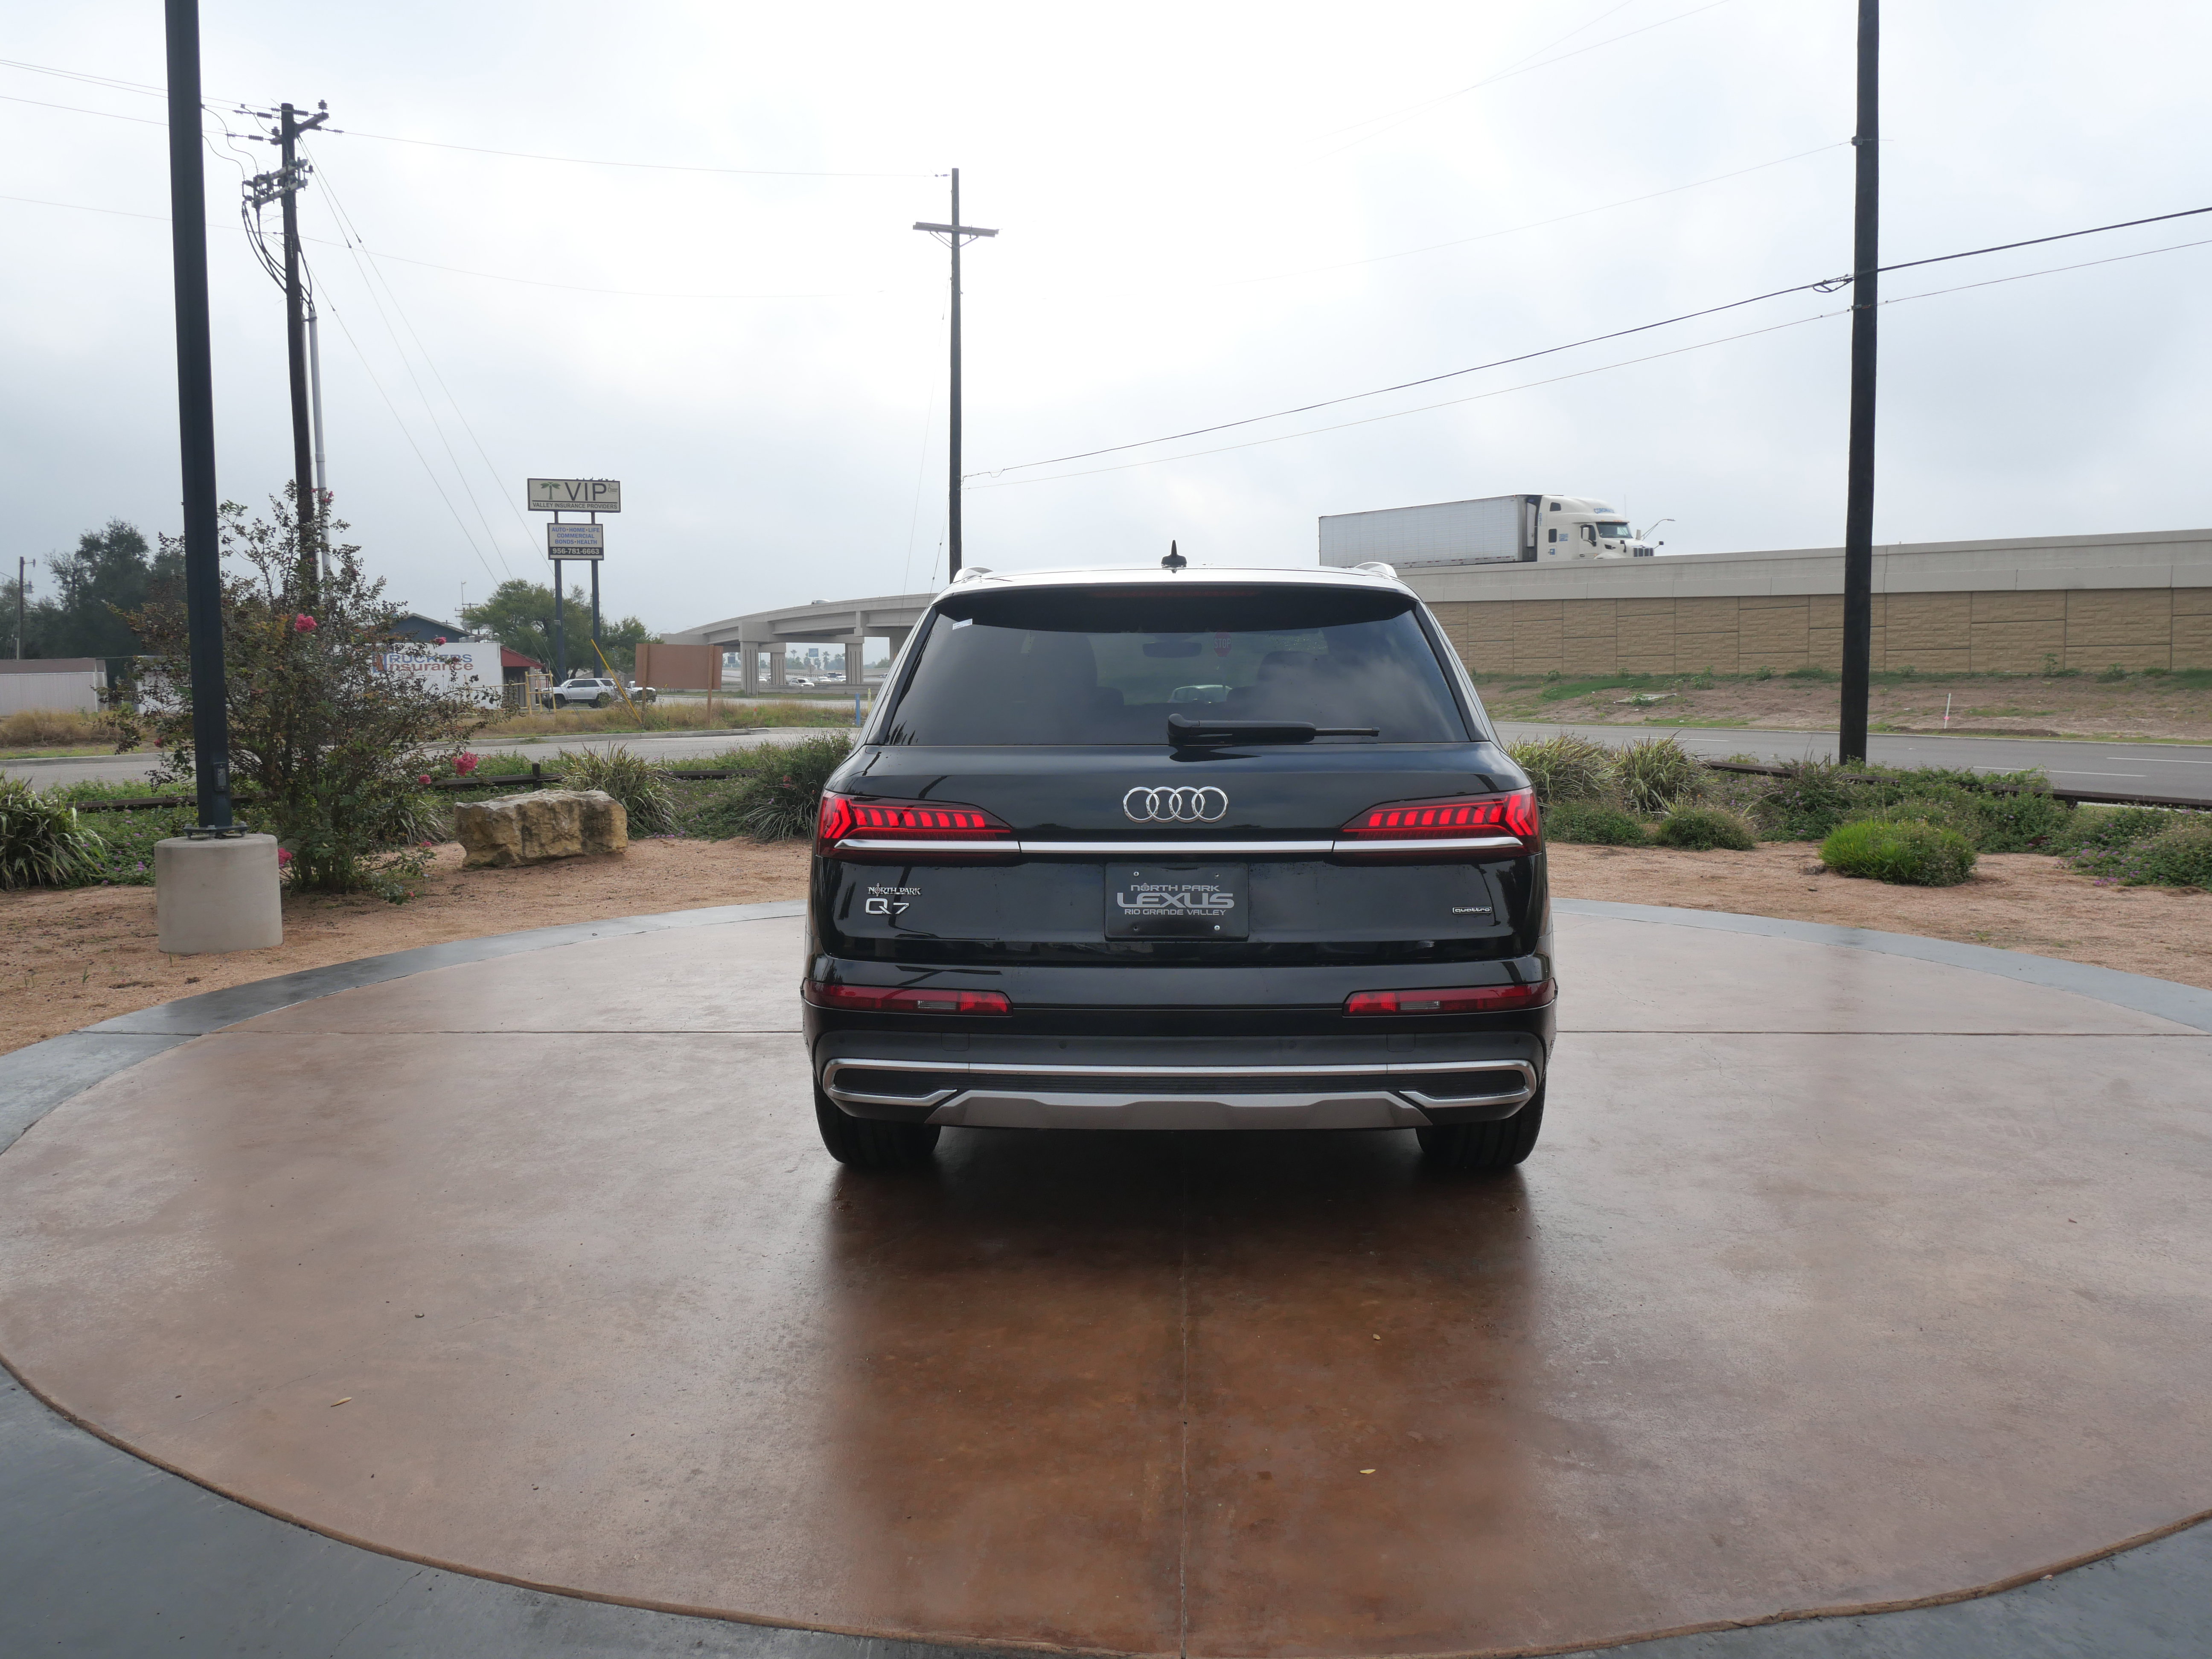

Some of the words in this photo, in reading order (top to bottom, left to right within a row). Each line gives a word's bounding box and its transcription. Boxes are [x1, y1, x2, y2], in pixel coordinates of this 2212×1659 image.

[565, 482, 607, 501] VIP
[1214, 638, 1231, 649] STOP
[867, 885, 896, 895] NORTH
[865, 898, 909, 914] Q7
[1117, 893, 1234, 908] LEXUS
